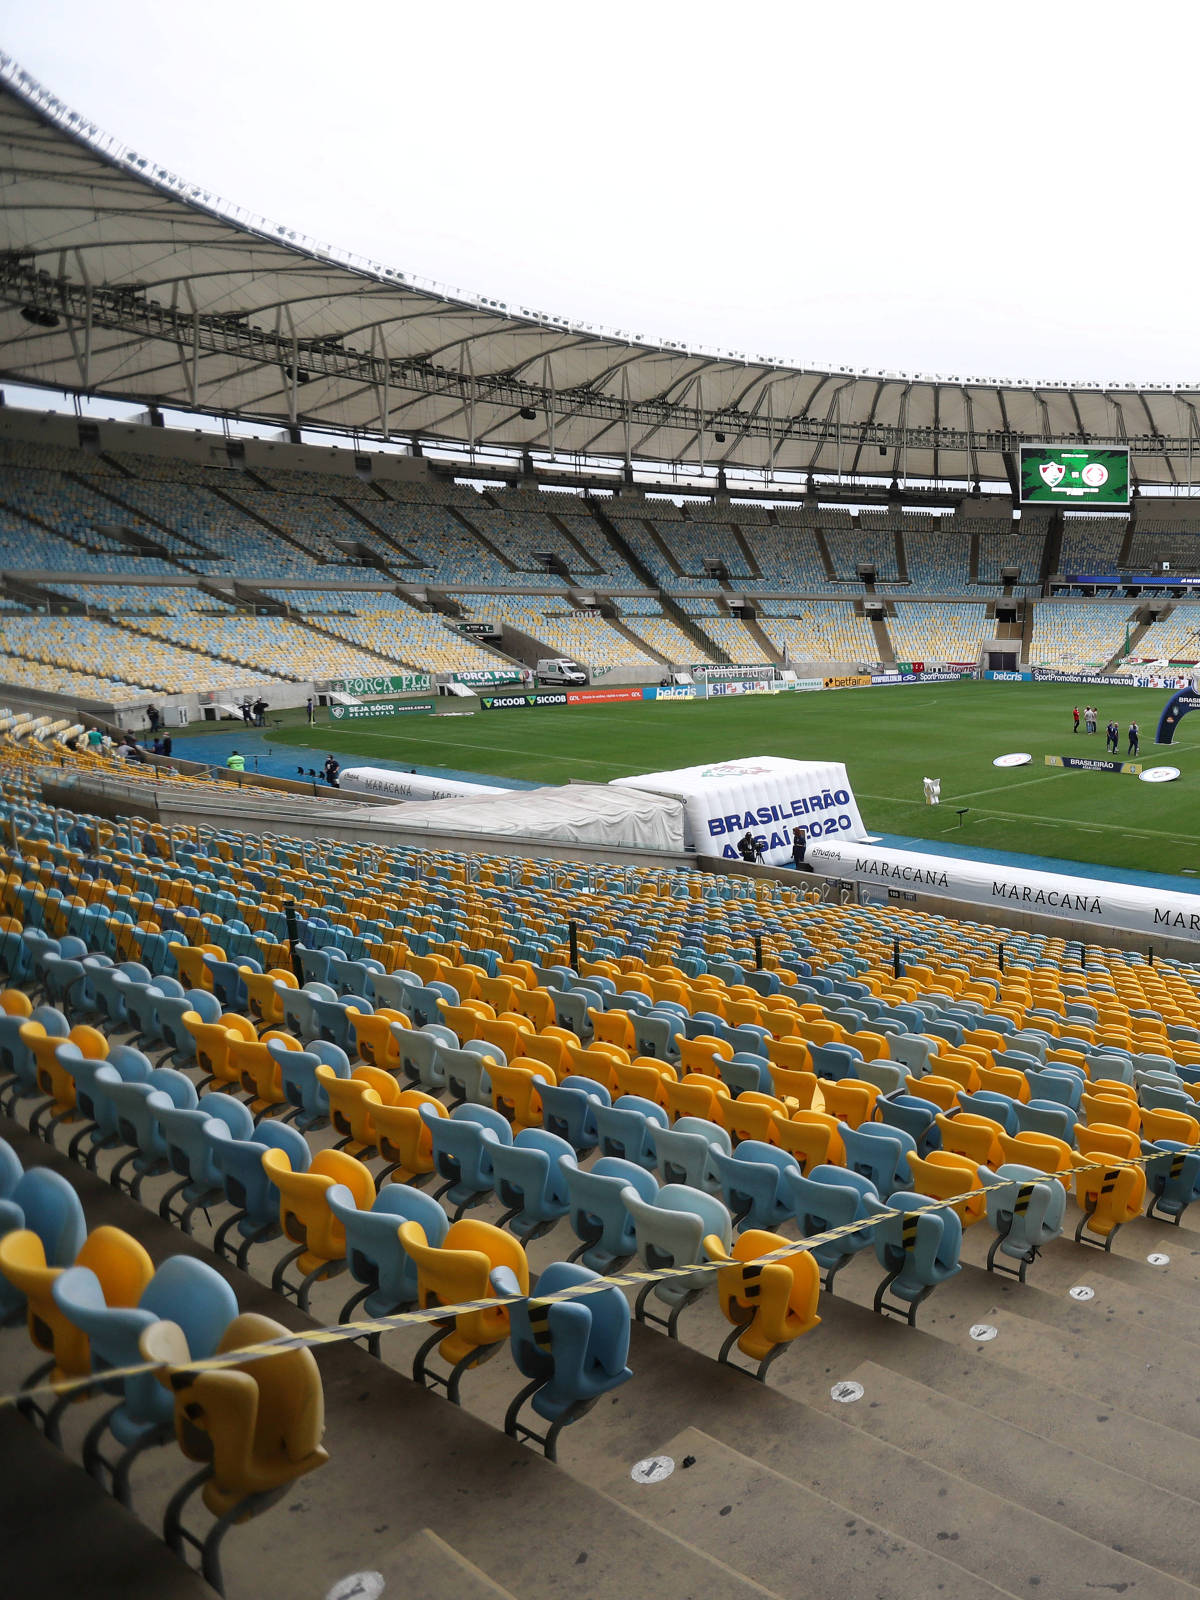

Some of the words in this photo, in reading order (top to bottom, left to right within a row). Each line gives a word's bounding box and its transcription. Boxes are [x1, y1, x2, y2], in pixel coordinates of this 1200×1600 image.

[457, 671, 492, 680] FORÇA
[920, 672, 960, 681] SportPromotion
[993, 672, 1022, 680] betcris
[1034, 673, 1081, 682] SportPromotion
[1087, 676, 1109, 684] PAIXÃO
[742, 682, 755, 692] Sil
[834, 677, 862, 687] betfair
[1138, 678, 1149, 687] Sil
[1163, 679, 1175, 688] Sil
[656, 685, 697, 697] betcris
[713, 683, 726, 695] Sil
[493, 697, 526, 707] SICOOB
[537, 695, 566, 704] SICOOB
[371, 704, 395, 712] SÓCIO
[1070, 758, 1113, 769] BRASILEIRÃO
[708, 789, 850, 836] BRASILEIRÃO
[855, 858, 949, 888] MARACANÃ
[992, 881, 1103, 914] MARACANÃ
